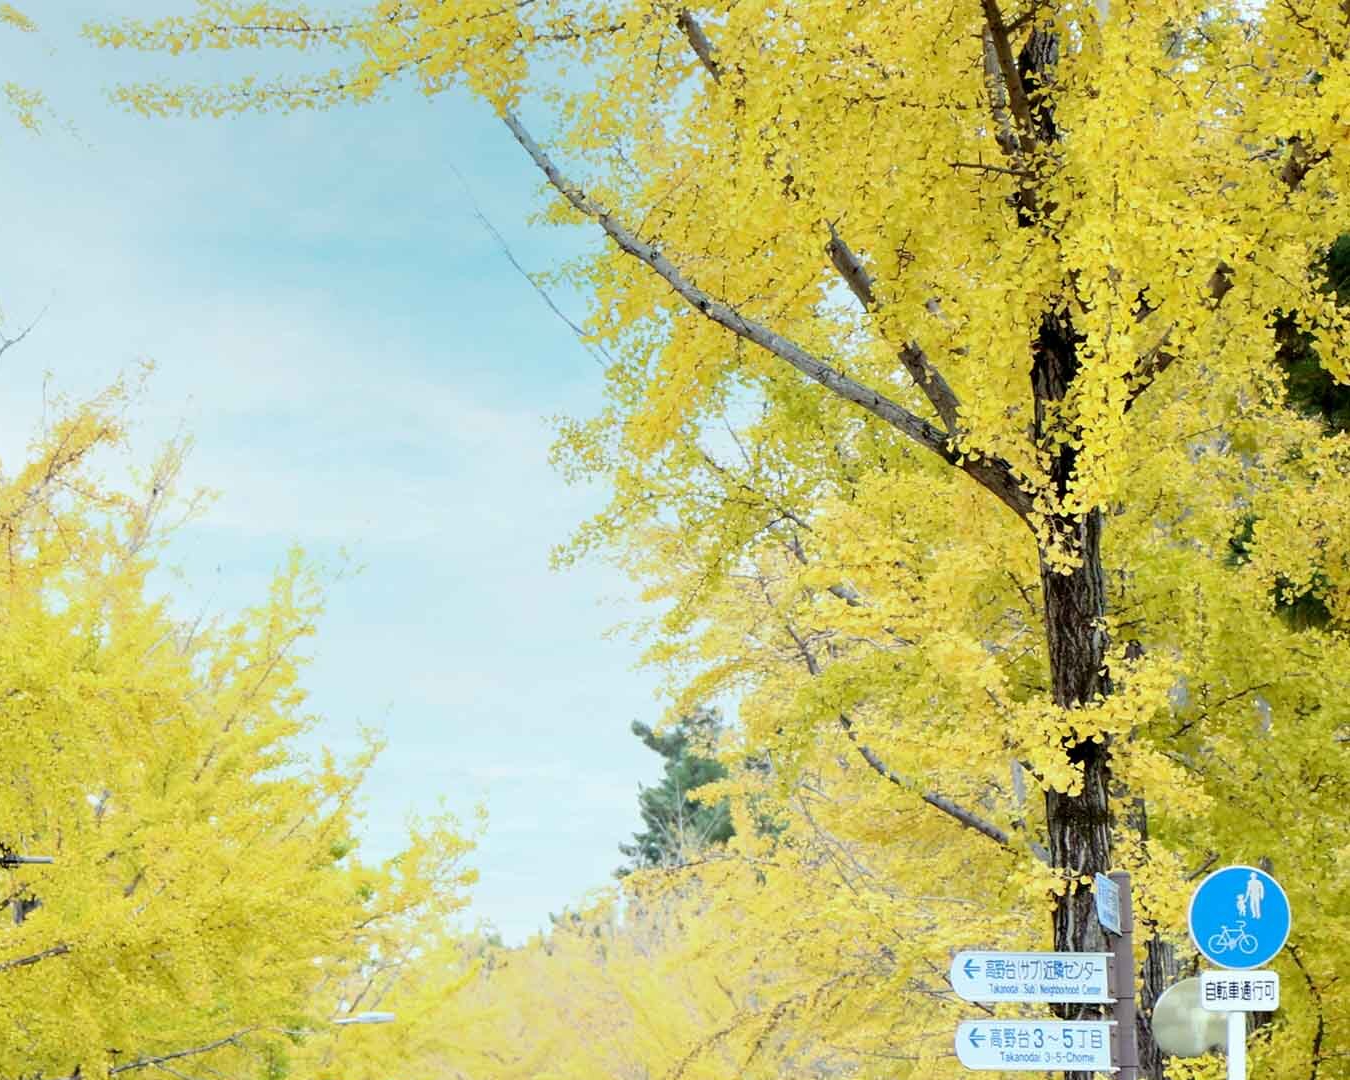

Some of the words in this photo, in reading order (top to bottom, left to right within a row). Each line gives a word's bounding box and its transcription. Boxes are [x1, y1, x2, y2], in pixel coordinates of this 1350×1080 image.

[1206, 980, 1274, 1001] 自転車通行可
[1000, 1051, 1041, 1063] Takanodai
